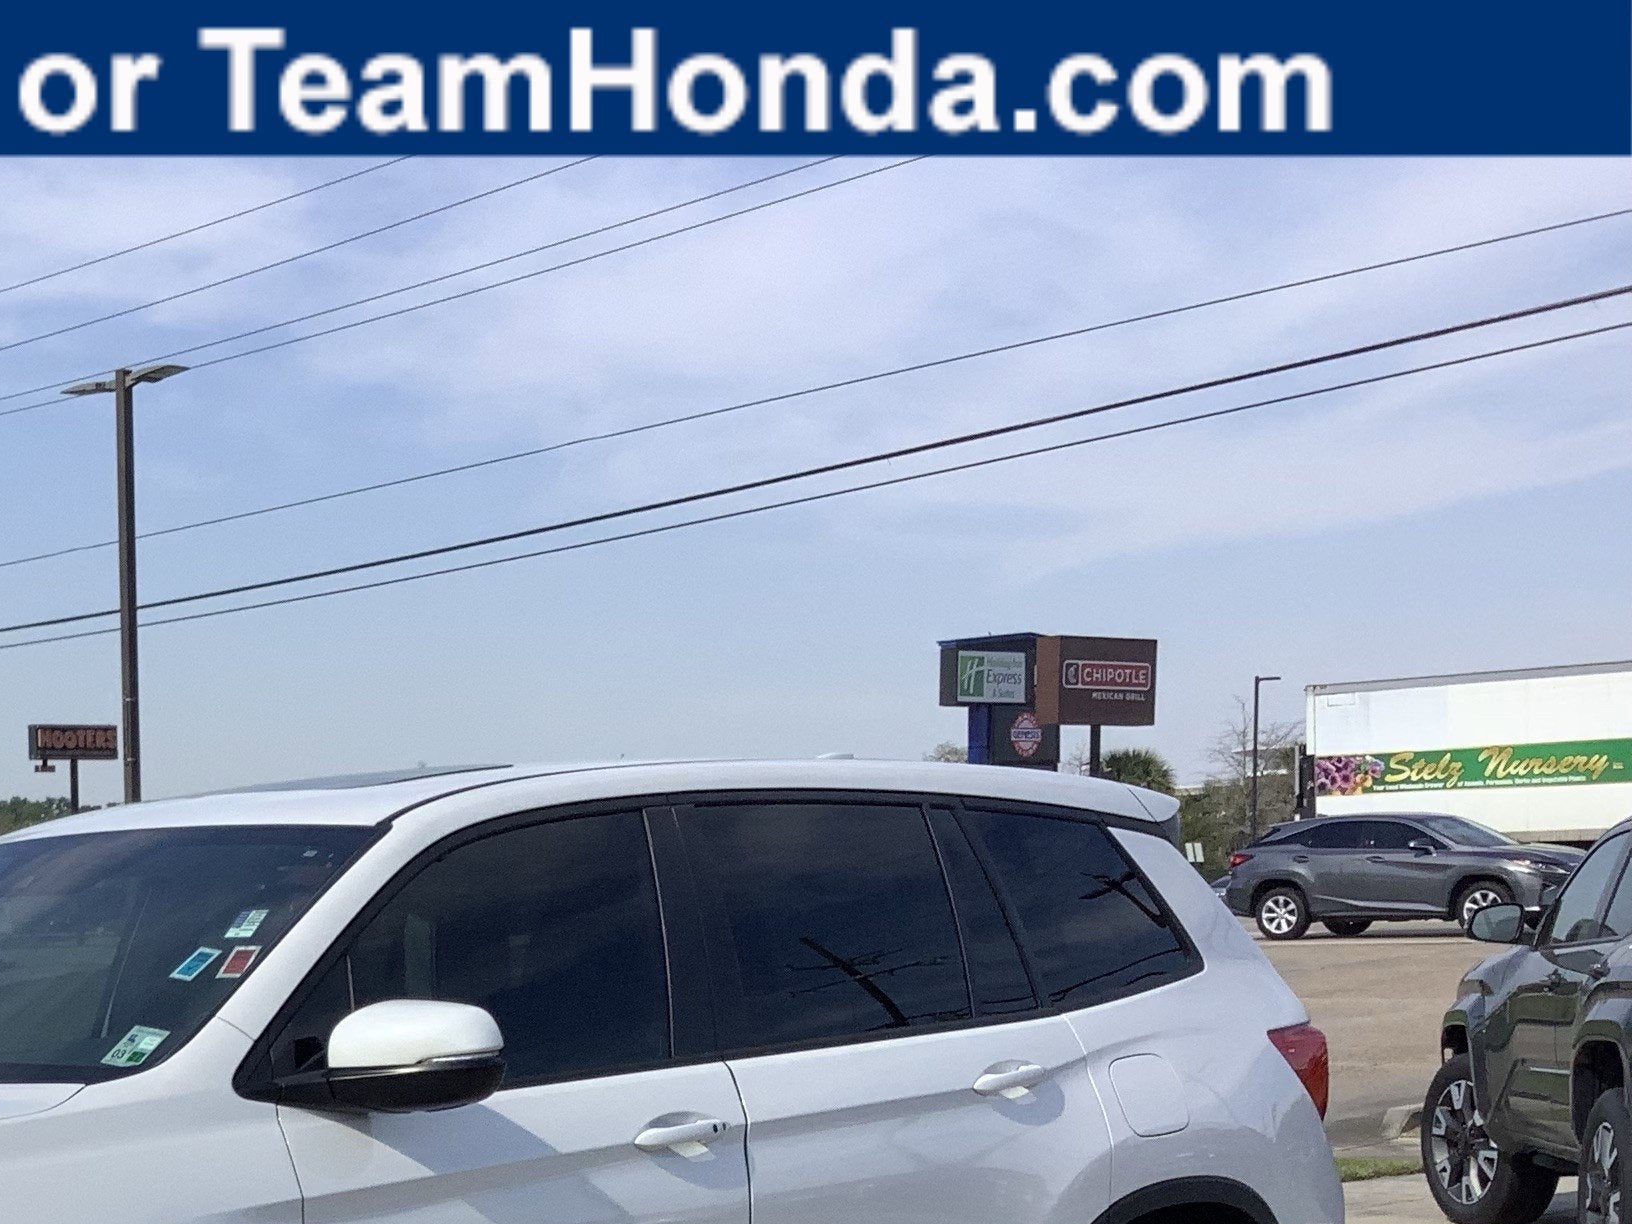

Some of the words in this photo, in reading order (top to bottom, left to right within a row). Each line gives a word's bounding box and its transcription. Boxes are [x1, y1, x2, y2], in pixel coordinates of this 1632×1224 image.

[986, 669, 1022, 686] Express
[1083, 668, 1146, 683] CHIPOTLE
[37, 728, 116, 750] HOOTERS
[1384, 751, 1464, 789] Stelz
[1478, 745, 1609, 780] Nursery
